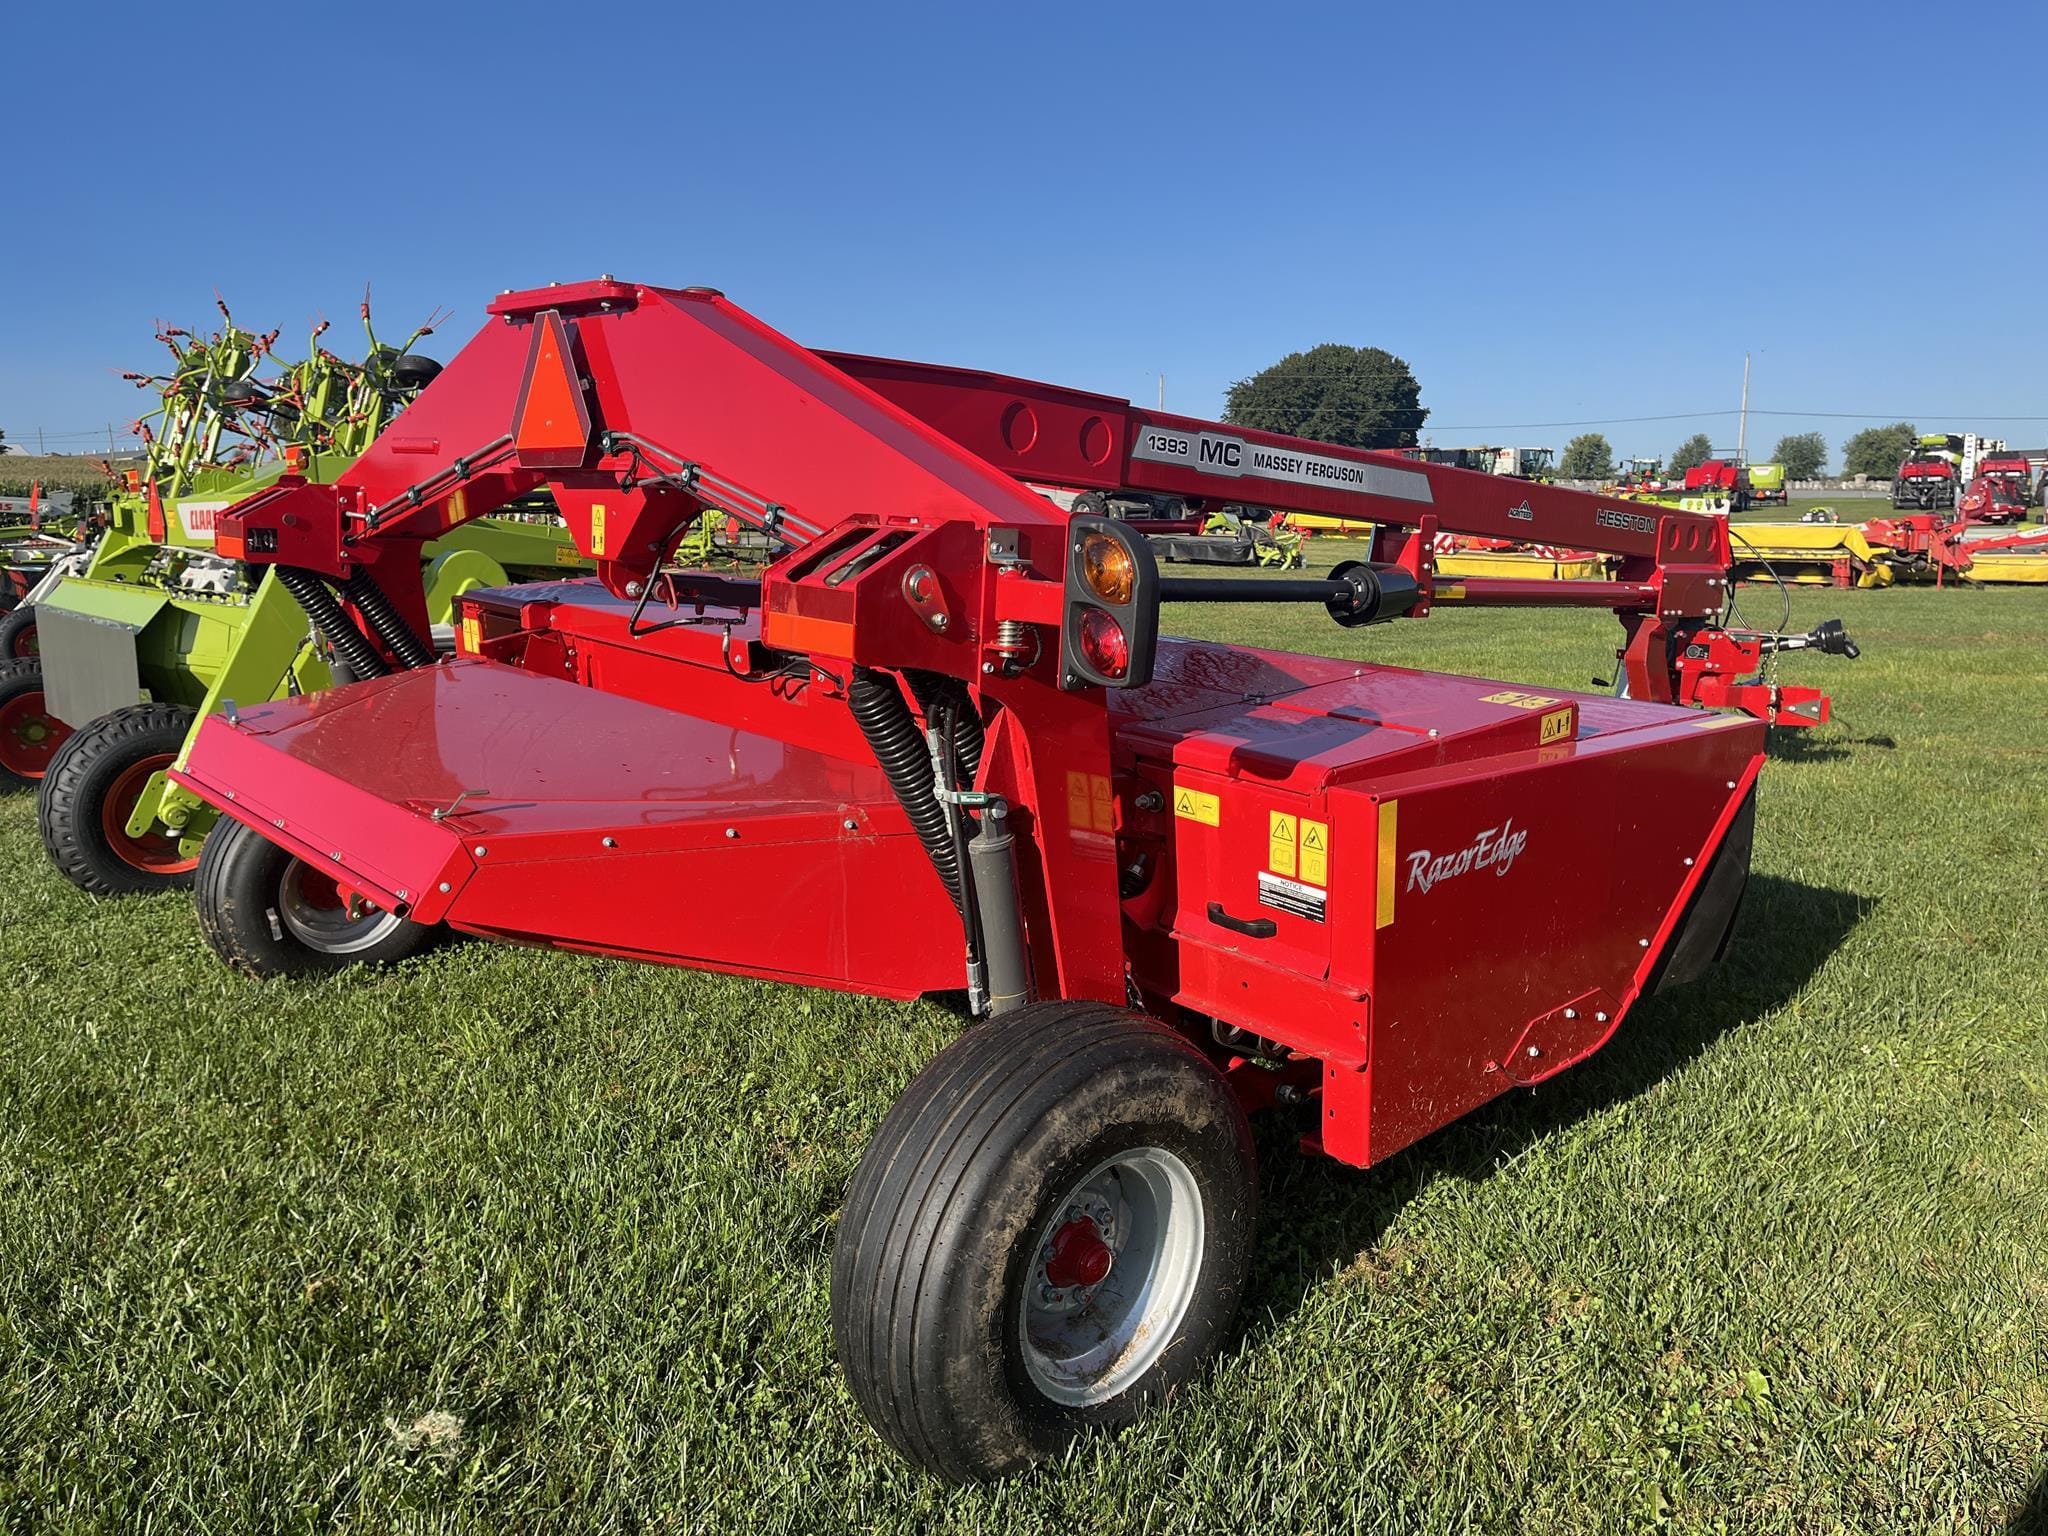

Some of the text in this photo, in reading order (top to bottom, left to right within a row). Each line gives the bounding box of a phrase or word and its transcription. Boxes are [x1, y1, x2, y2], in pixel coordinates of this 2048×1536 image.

[1147, 434, 1364, 484] 1393 MC MASSEY FERGUSON
[1596, 508, 1656, 533] HESSTON
[1405, 816, 1527, 895] RazorEdge
[1280, 879, 1303, 892] NOTICE
